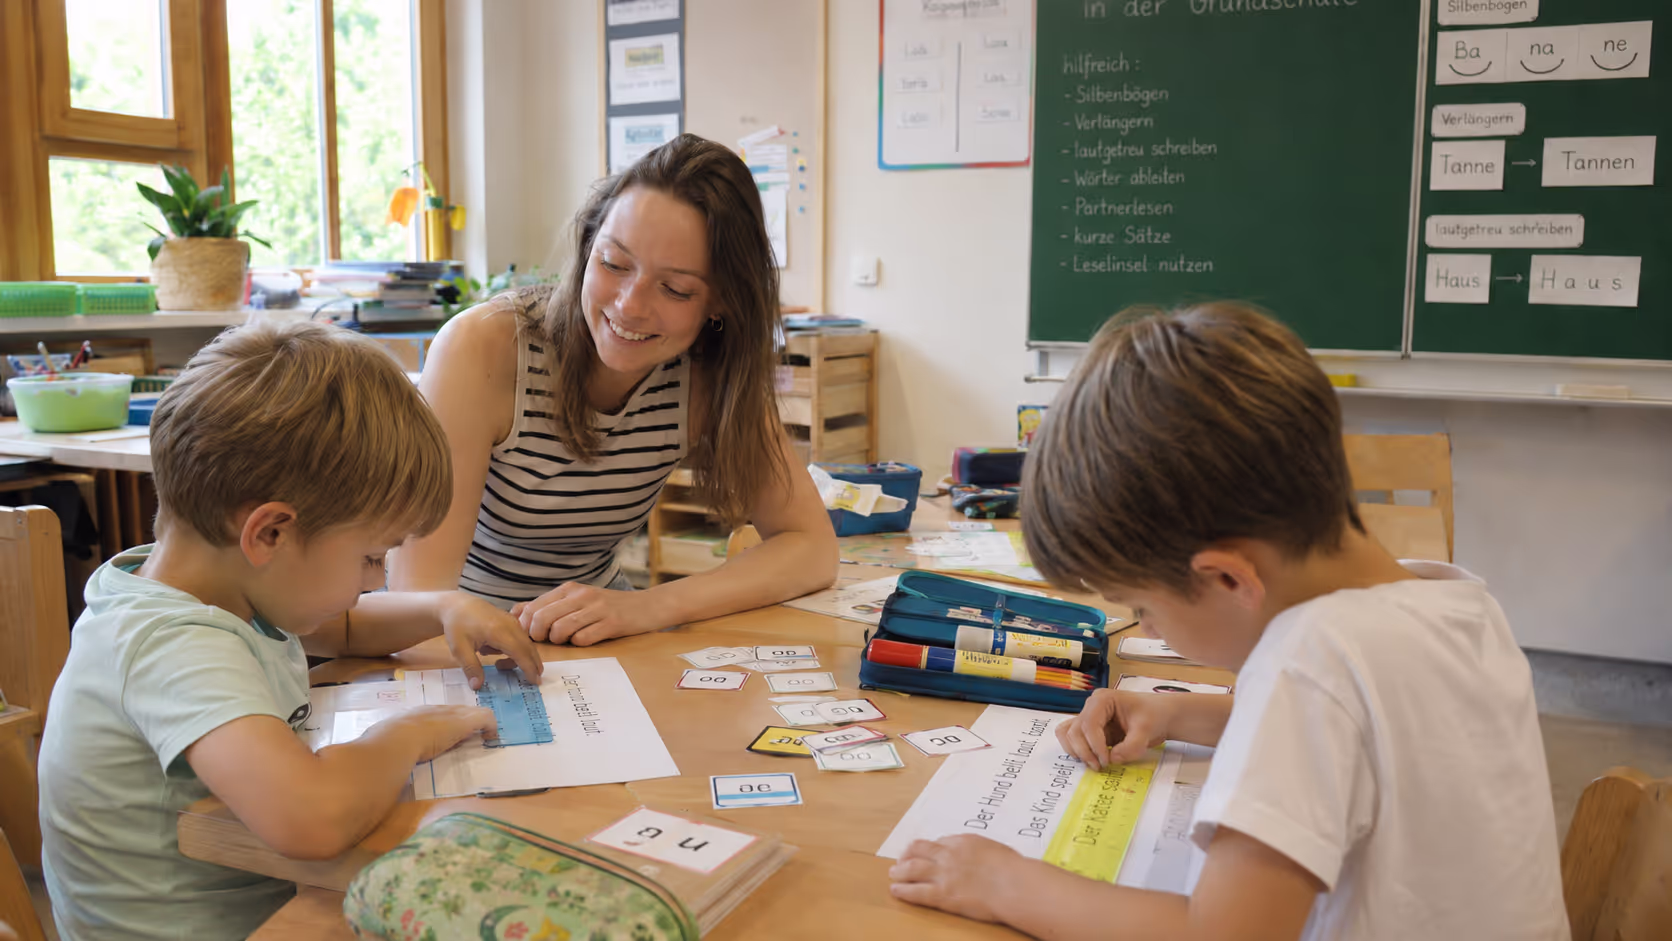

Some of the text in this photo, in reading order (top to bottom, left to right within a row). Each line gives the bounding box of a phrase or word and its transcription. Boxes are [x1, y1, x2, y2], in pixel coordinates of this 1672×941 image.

[1454, 38, 1628, 59] Ba na ne
[1063, 52, 1130, 80] hilfreich
[1076, 83, 1169, 108] Silbenbögen
[1074, 112, 1154, 135] Verlängern
[1441, 112, 1514, 126] Verlängern
[1074, 140, 1144, 164] lautgetreu
[1151, 138, 1217, 156] schreiben
[1561, 150, 1635, 171] Tannen
[1440, 154, 1496, 175] Tanne
[1074, 169, 1122, 187] Wörter
[1130, 167, 1185, 185] ableiten
[1075, 197, 1174, 216] Partnerlesen
[1074, 226, 1115, 244] kurze
[1125, 225, 1171, 244] Sätze
[1435, 223, 1573, 239] lautgetreu schreiben
[1073, 254, 1148, 273] Leselinsel
[1158, 253, 1214, 273] nutzen
[1435, 265, 1481, 289] Haus
[978, 779, 1013, 808] Hund
[1029, 790, 1062, 815] Kind
[963, 808, 996, 830] Der
